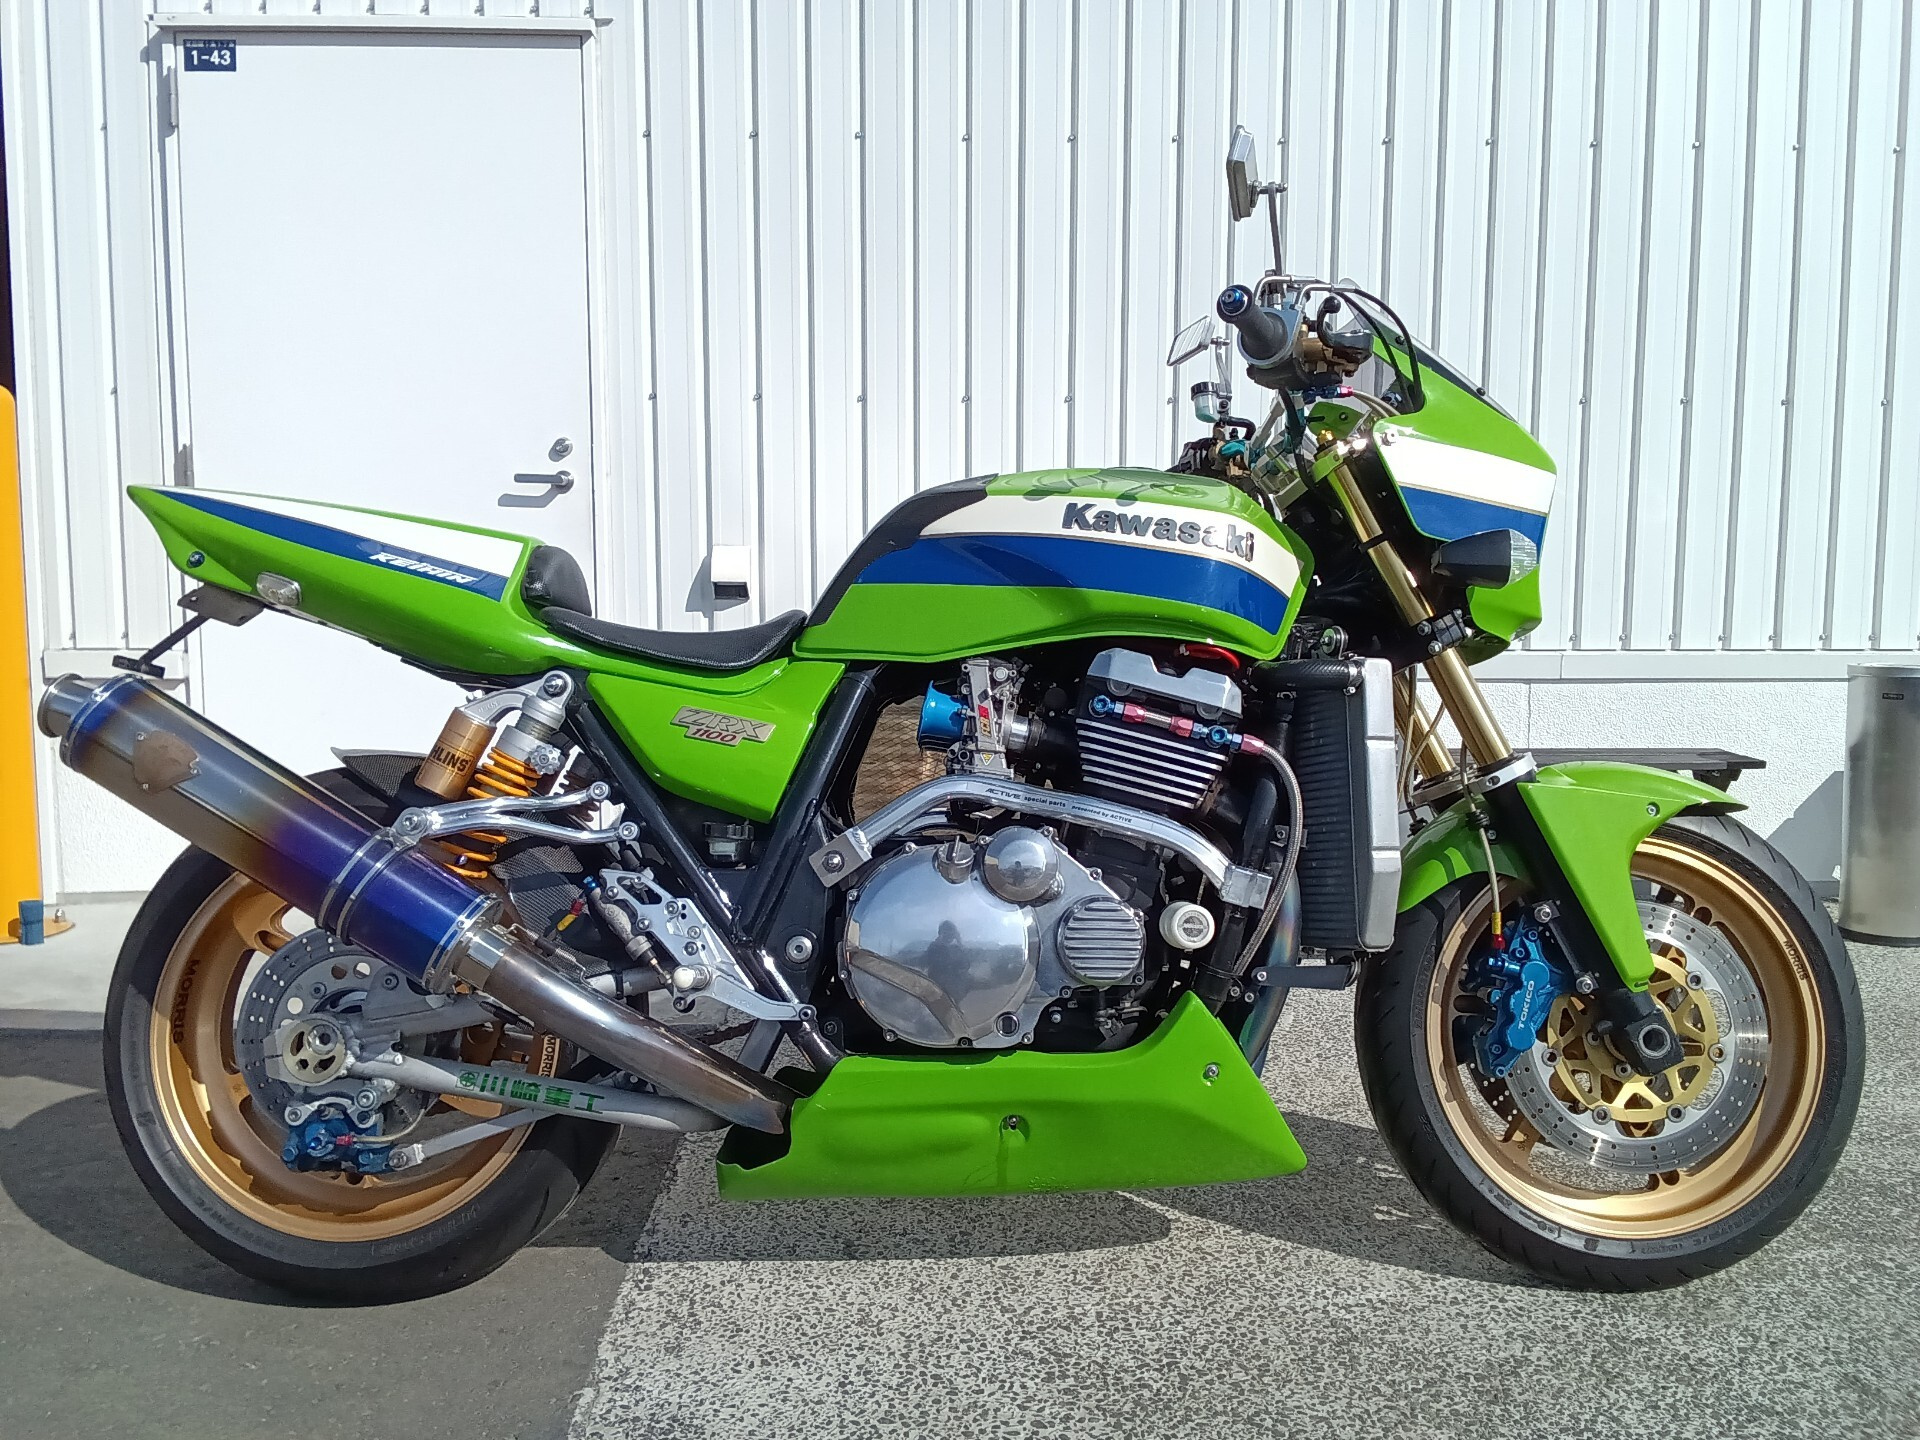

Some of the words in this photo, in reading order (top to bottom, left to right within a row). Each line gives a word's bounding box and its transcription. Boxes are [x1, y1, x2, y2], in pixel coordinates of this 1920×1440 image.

[191, 50, 231, 66] 1-43
[1062, 502, 1255, 562] Kawasaki
[679, 708, 768, 739] ZRX
[691, 728, 737, 742] 1100
[985, 788, 1021, 799] ACTIVE
[1024, 796, 1048, 804] special
[1048, 800, 1066, 808] parts
[1110, 814, 1132, 823] ACTIVE
[1783, 940, 1809, 981] MORRIS
[173, 959, 200, 1044] MORRIS
[1518, 980, 1535, 1029] TOKICO
